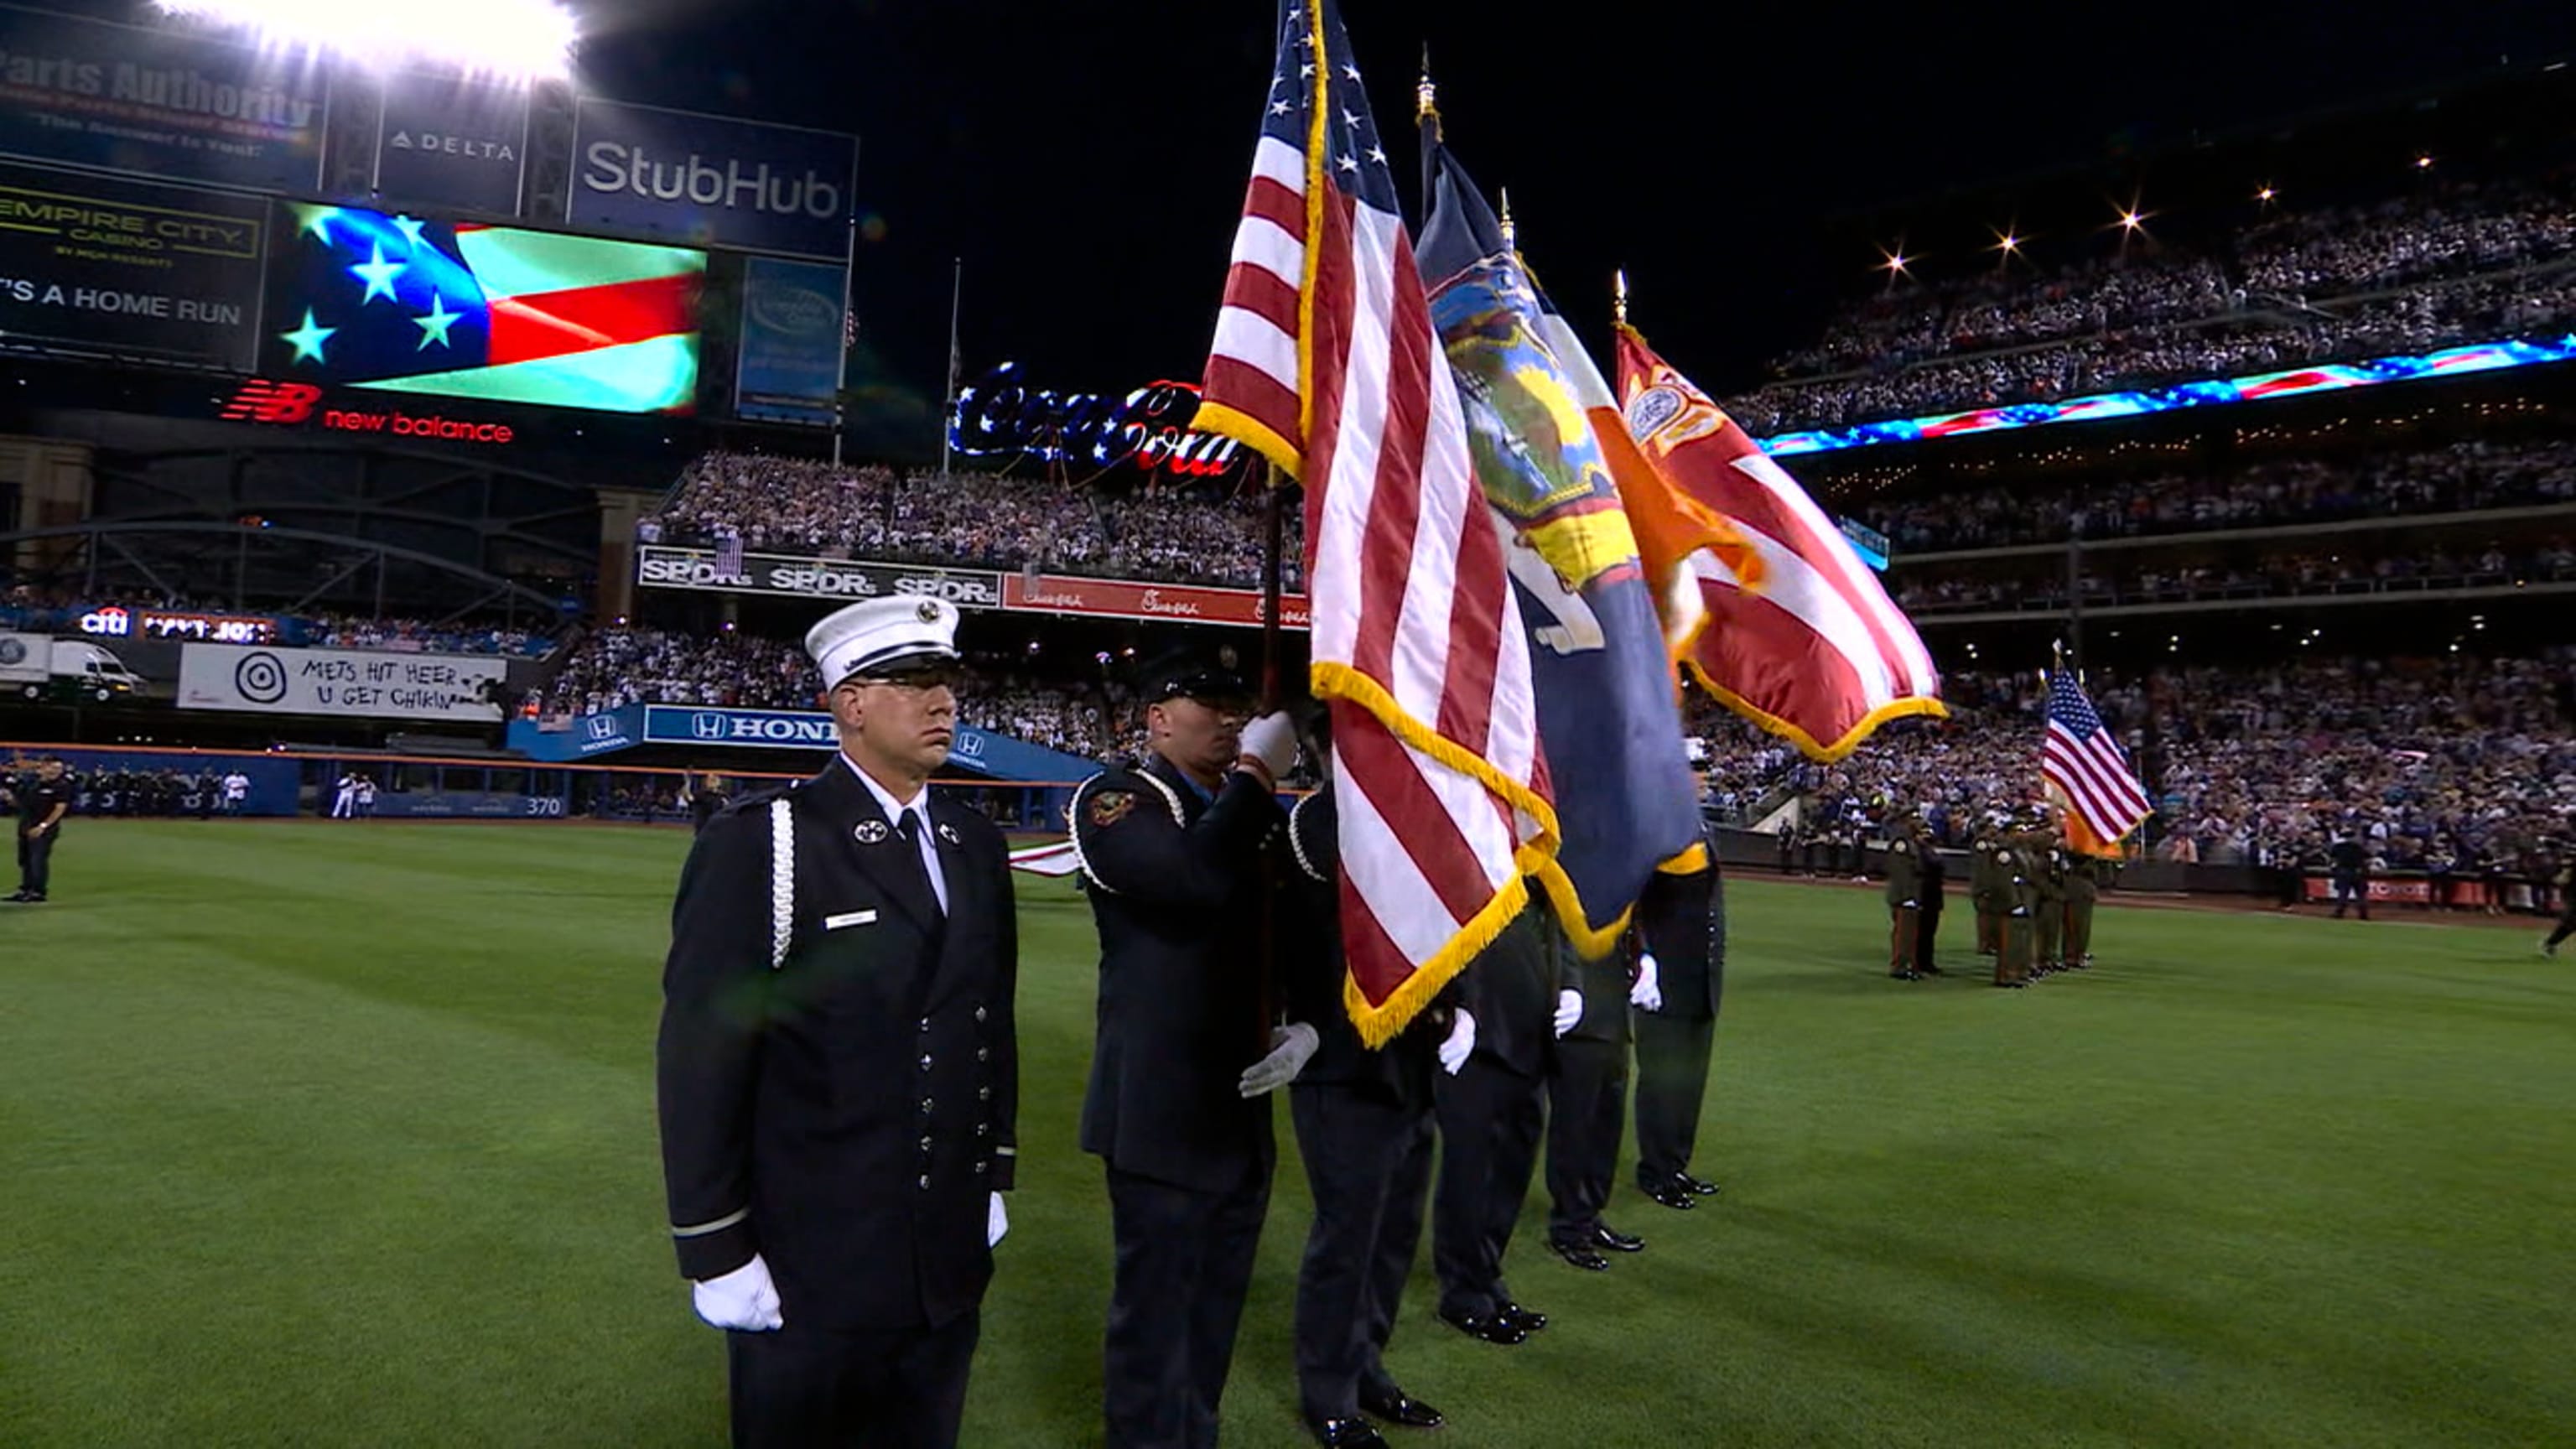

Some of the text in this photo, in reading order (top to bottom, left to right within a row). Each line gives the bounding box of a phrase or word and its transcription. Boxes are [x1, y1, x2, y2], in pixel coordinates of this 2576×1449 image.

[111, 62, 315, 128] Authority
[422, 134, 514, 162] DELTA
[584, 141, 839, 218] StubHub
[0, 200, 243, 244] EMPIRE CITY
[69, 228, 164, 251] CASINO
[42, 285, 65, 305] A
[75, 288, 169, 317] HOME
[178, 300, 240, 325] RUN
[325, 410, 514, 444] new balance
[81, 609, 127, 635] citi
[302, 660, 455, 685] METS HIT HEER
[317, 687, 333, 703] U
[342, 688, 379, 706] GET
[580, 735, 630, 752] HONDA
[527, 798, 561, 815] 370
